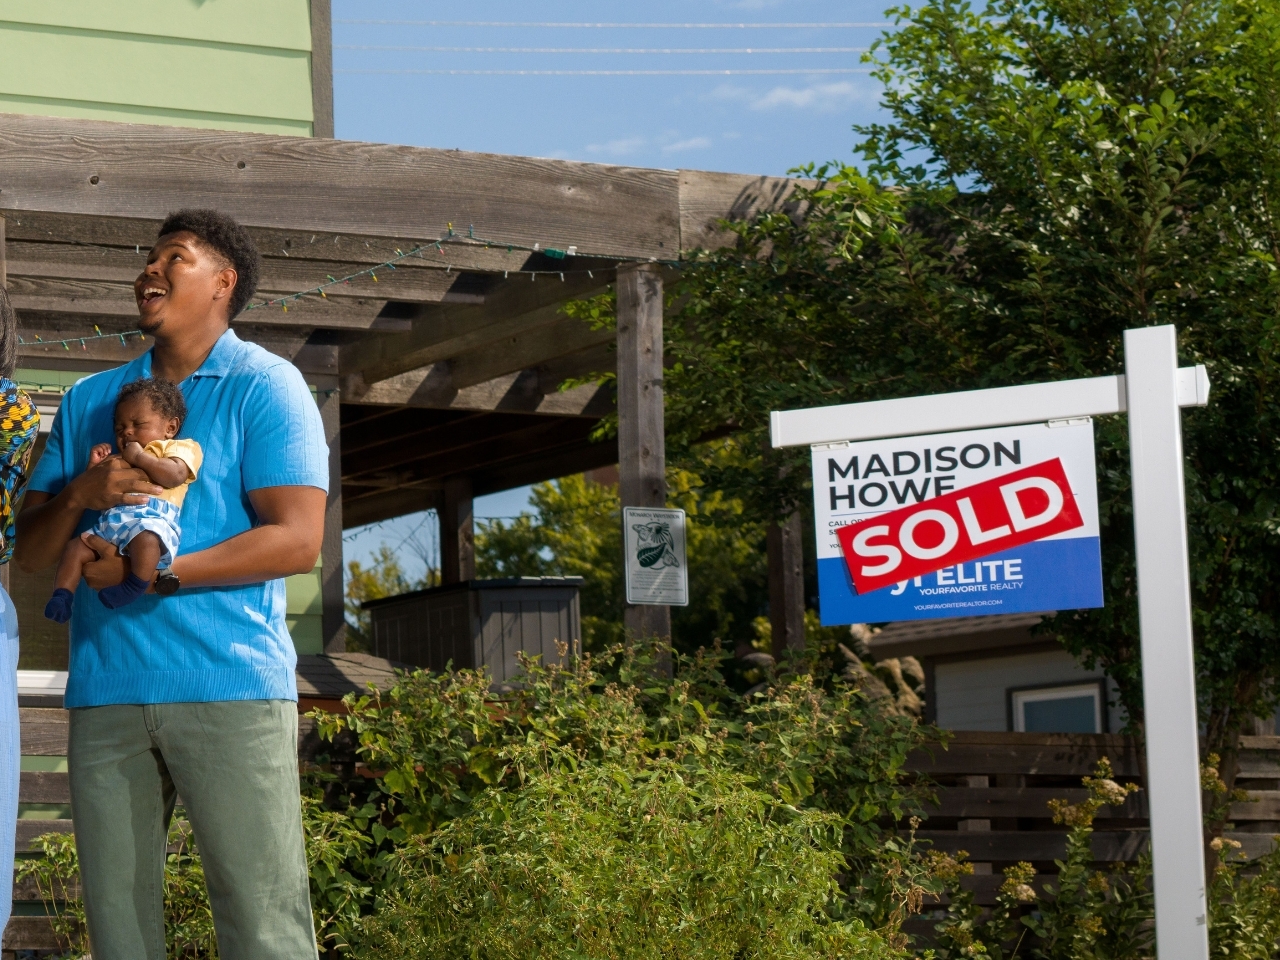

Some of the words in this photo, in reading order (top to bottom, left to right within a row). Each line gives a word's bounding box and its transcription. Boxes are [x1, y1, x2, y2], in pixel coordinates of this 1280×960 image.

[828, 439, 1021, 482] MADISON
[852, 476, 1064, 577] SOLD
[919, 584, 988, 596] YOURFAVORITE
[990, 581, 1024, 591] REALTY
[936, 558, 1024, 586] ELITE
